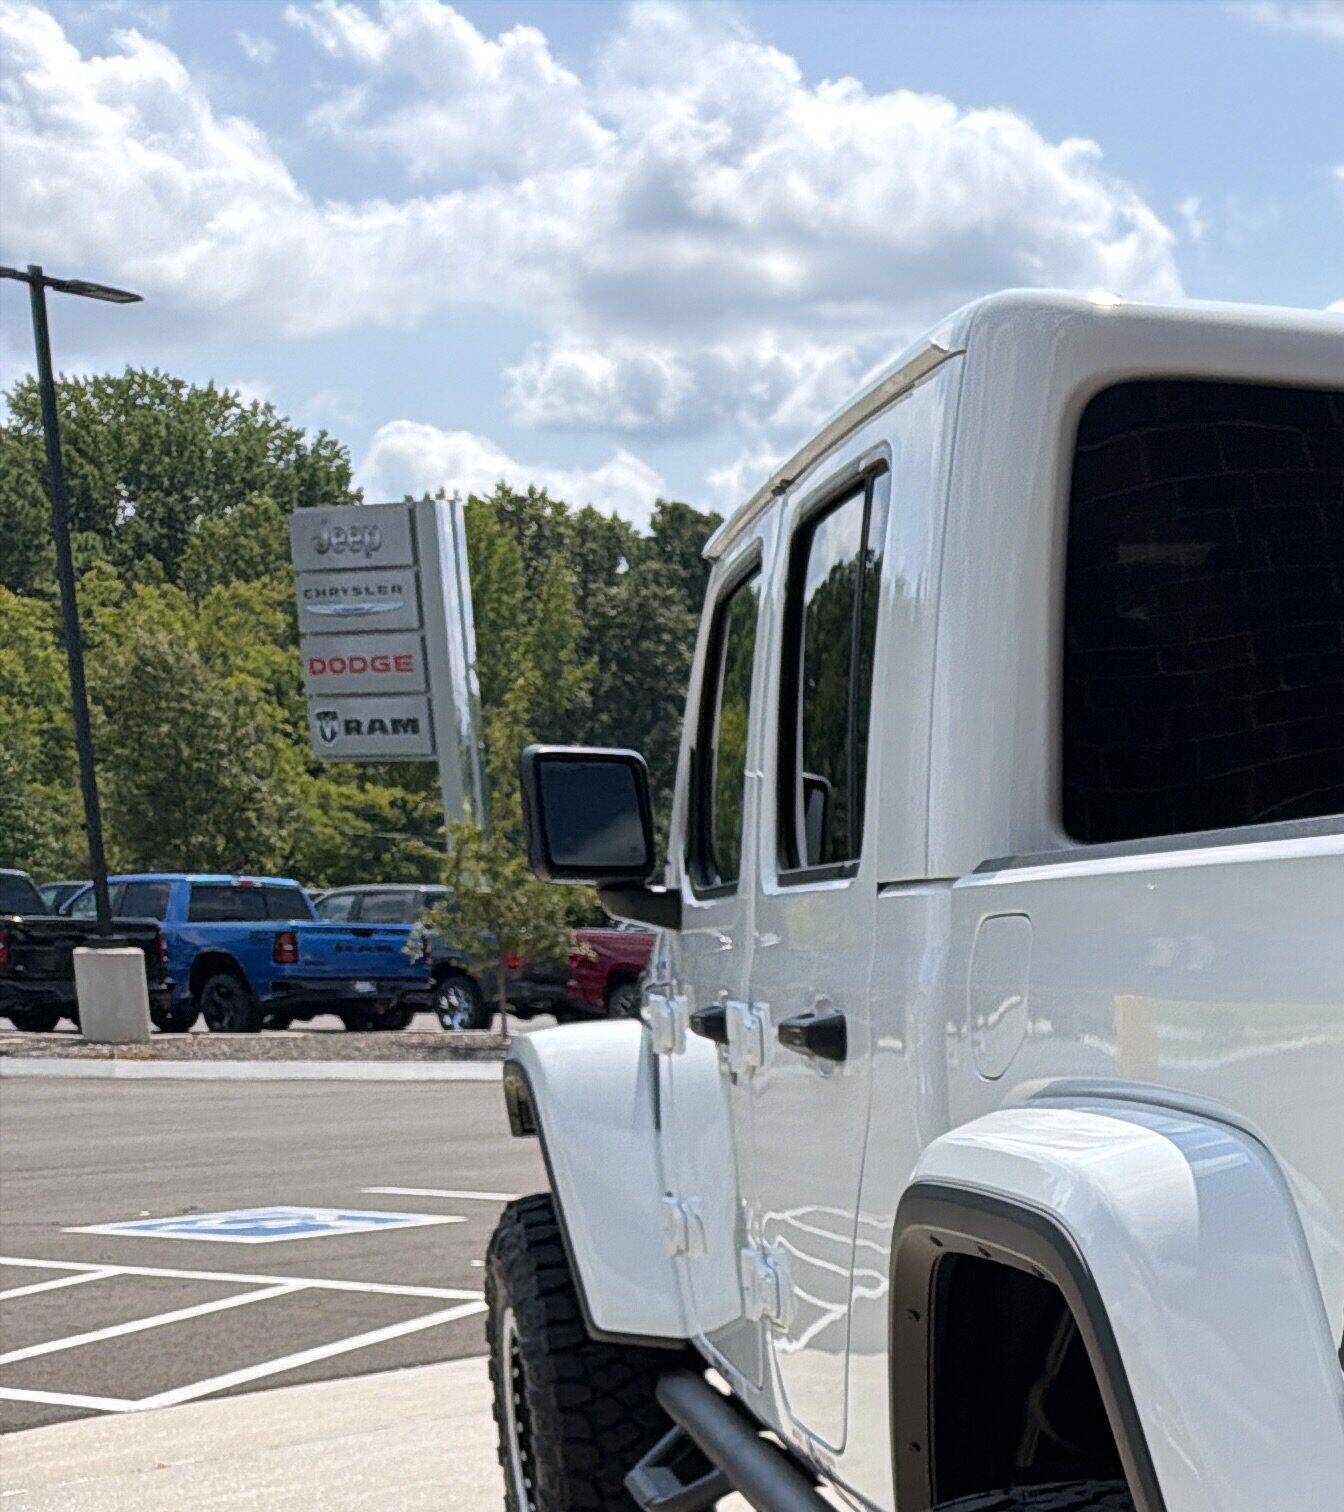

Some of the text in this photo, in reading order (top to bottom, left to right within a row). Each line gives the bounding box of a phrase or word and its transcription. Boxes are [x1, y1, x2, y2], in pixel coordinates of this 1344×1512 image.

[312, 517, 382, 559] Jeep
[303, 584, 403, 600] CHRYSLER
[309, 654, 414, 676] DODGE
[344, 717, 420, 736] RAM
